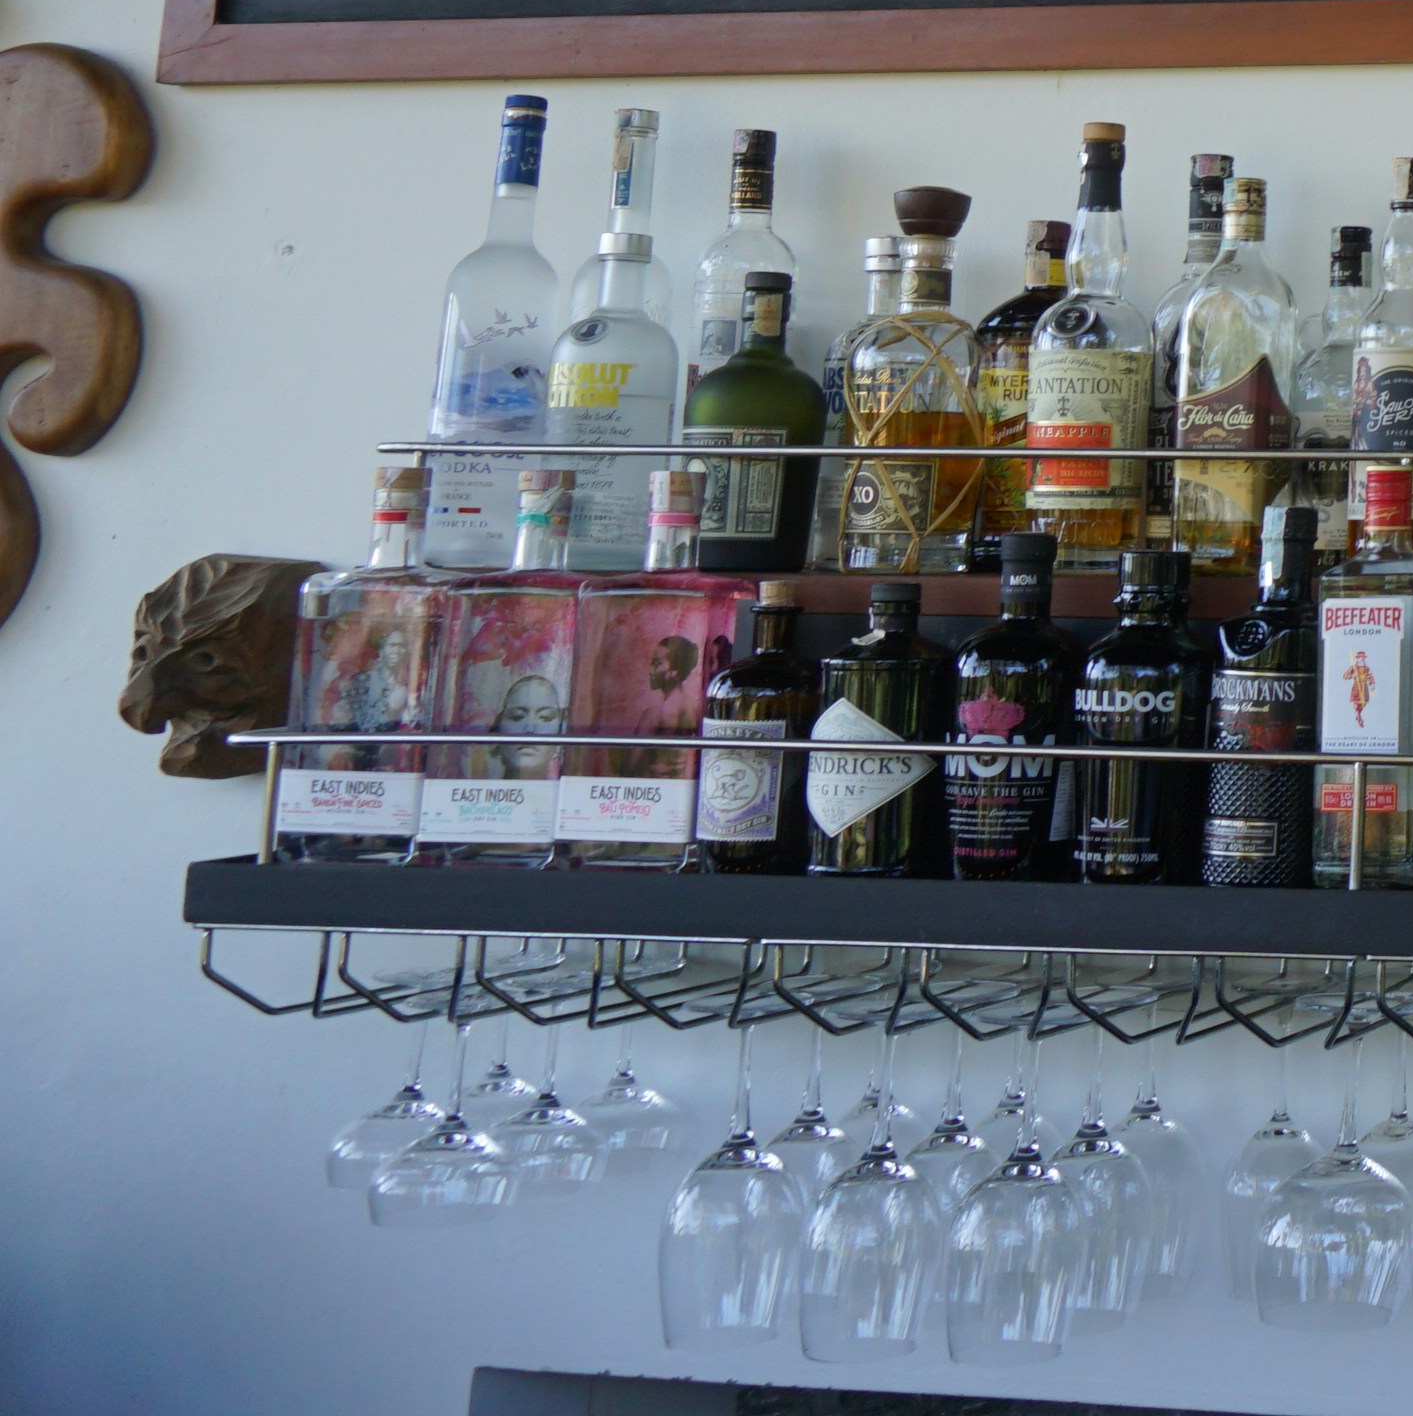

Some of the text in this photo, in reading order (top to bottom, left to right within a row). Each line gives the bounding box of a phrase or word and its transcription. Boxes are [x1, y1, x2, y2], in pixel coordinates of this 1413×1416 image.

[1178, 404, 1213, 430] Flor
[1223, 403, 1255, 429] Caña
[853, 485, 874, 505] XO
[1325, 606, 1402, 632] BEEFEATER
[1343, 628, 1382, 636] LONDON
[1075, 689, 1176, 713] BULLDOG
[311, 779, 385, 797] EAST INDIES
